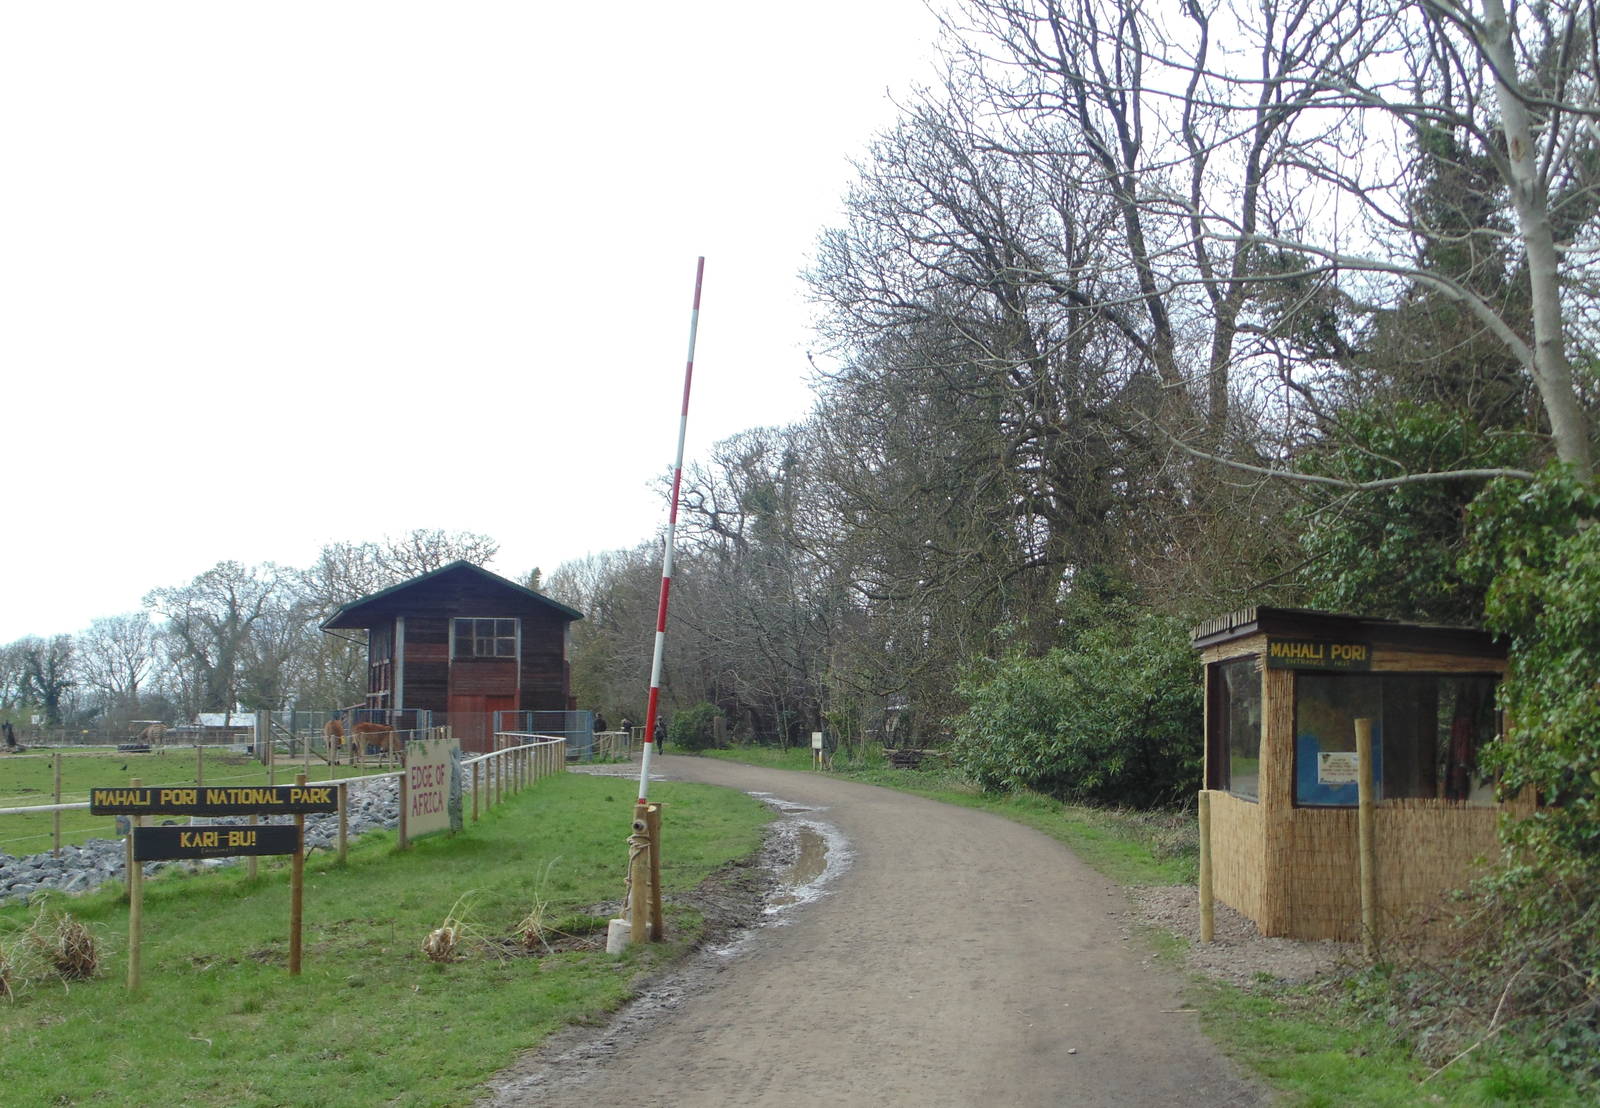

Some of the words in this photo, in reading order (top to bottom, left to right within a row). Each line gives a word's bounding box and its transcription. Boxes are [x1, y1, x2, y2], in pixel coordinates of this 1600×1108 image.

[1271, 642, 1323, 659] MAHALI
[1331, 645, 1366, 660] PORI
[412, 765, 432, 789] EDGE
[436, 764, 445, 785] OF
[95, 790, 150, 806] MAHALI
[160, 789, 198, 805] PORI
[206, 788, 284, 805] NATIONAL
[290, 788, 332, 804] PARK
[412, 791, 443, 816] AFRICA
